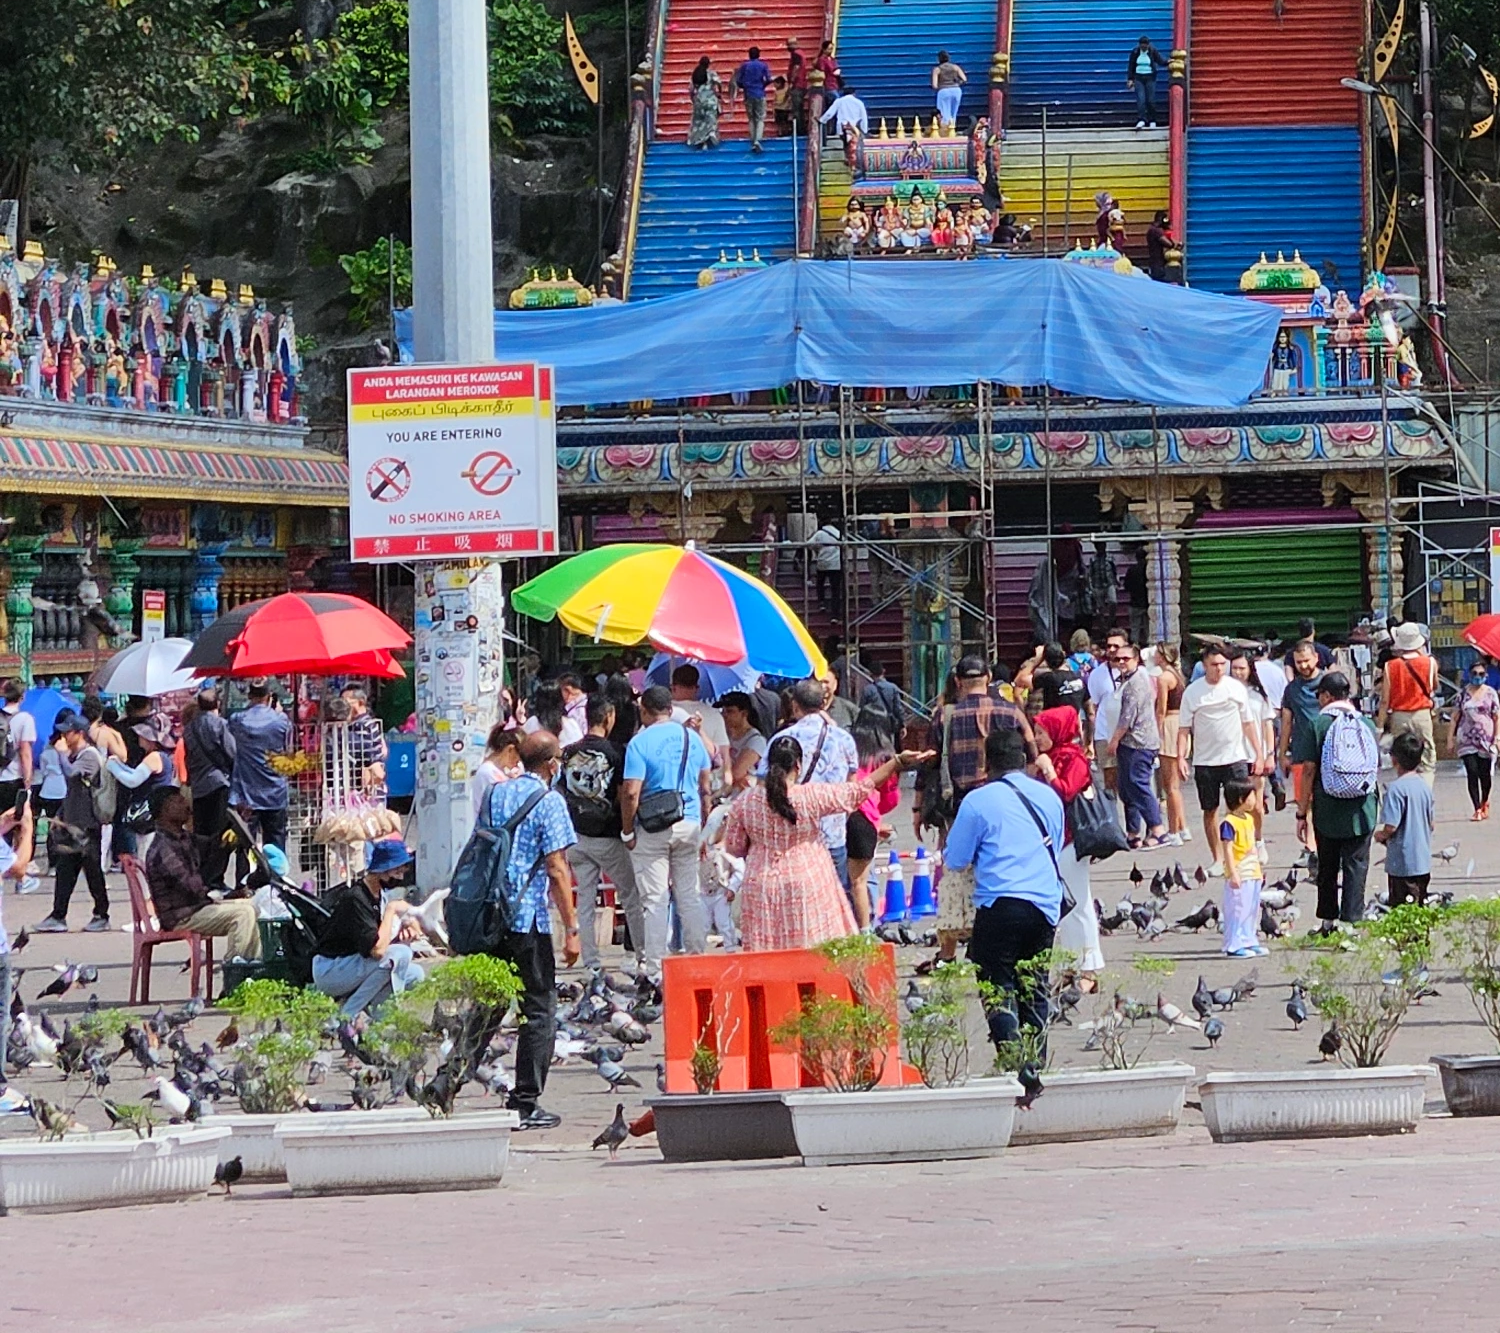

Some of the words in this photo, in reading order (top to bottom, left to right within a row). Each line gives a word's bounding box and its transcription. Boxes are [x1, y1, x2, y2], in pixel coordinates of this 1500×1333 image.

[363, 377, 394, 388] ANDA
[395, 374, 451, 386] MEMASUKI
[453, 374, 468, 384] KE
[470, 371, 523, 383] KAWASAN
[385, 388, 444, 400] LARANGAN
[447, 385, 499, 396] MEROKOK
[372, 404, 426, 420] புகைப்
[431, 399, 514, 417] பிடிக்காதீர்
[386, 432, 410, 444] YOU
[413, 430, 438, 442] ARE
[441, 427, 503, 441] ENTERING
[389, 513, 406, 524] NO
[409, 510, 465, 524] SMOKING
[468, 509, 502, 521] AREA
[373, 533, 513, 555] 禁止吸烟
[400, 753, 409, 768] 2
